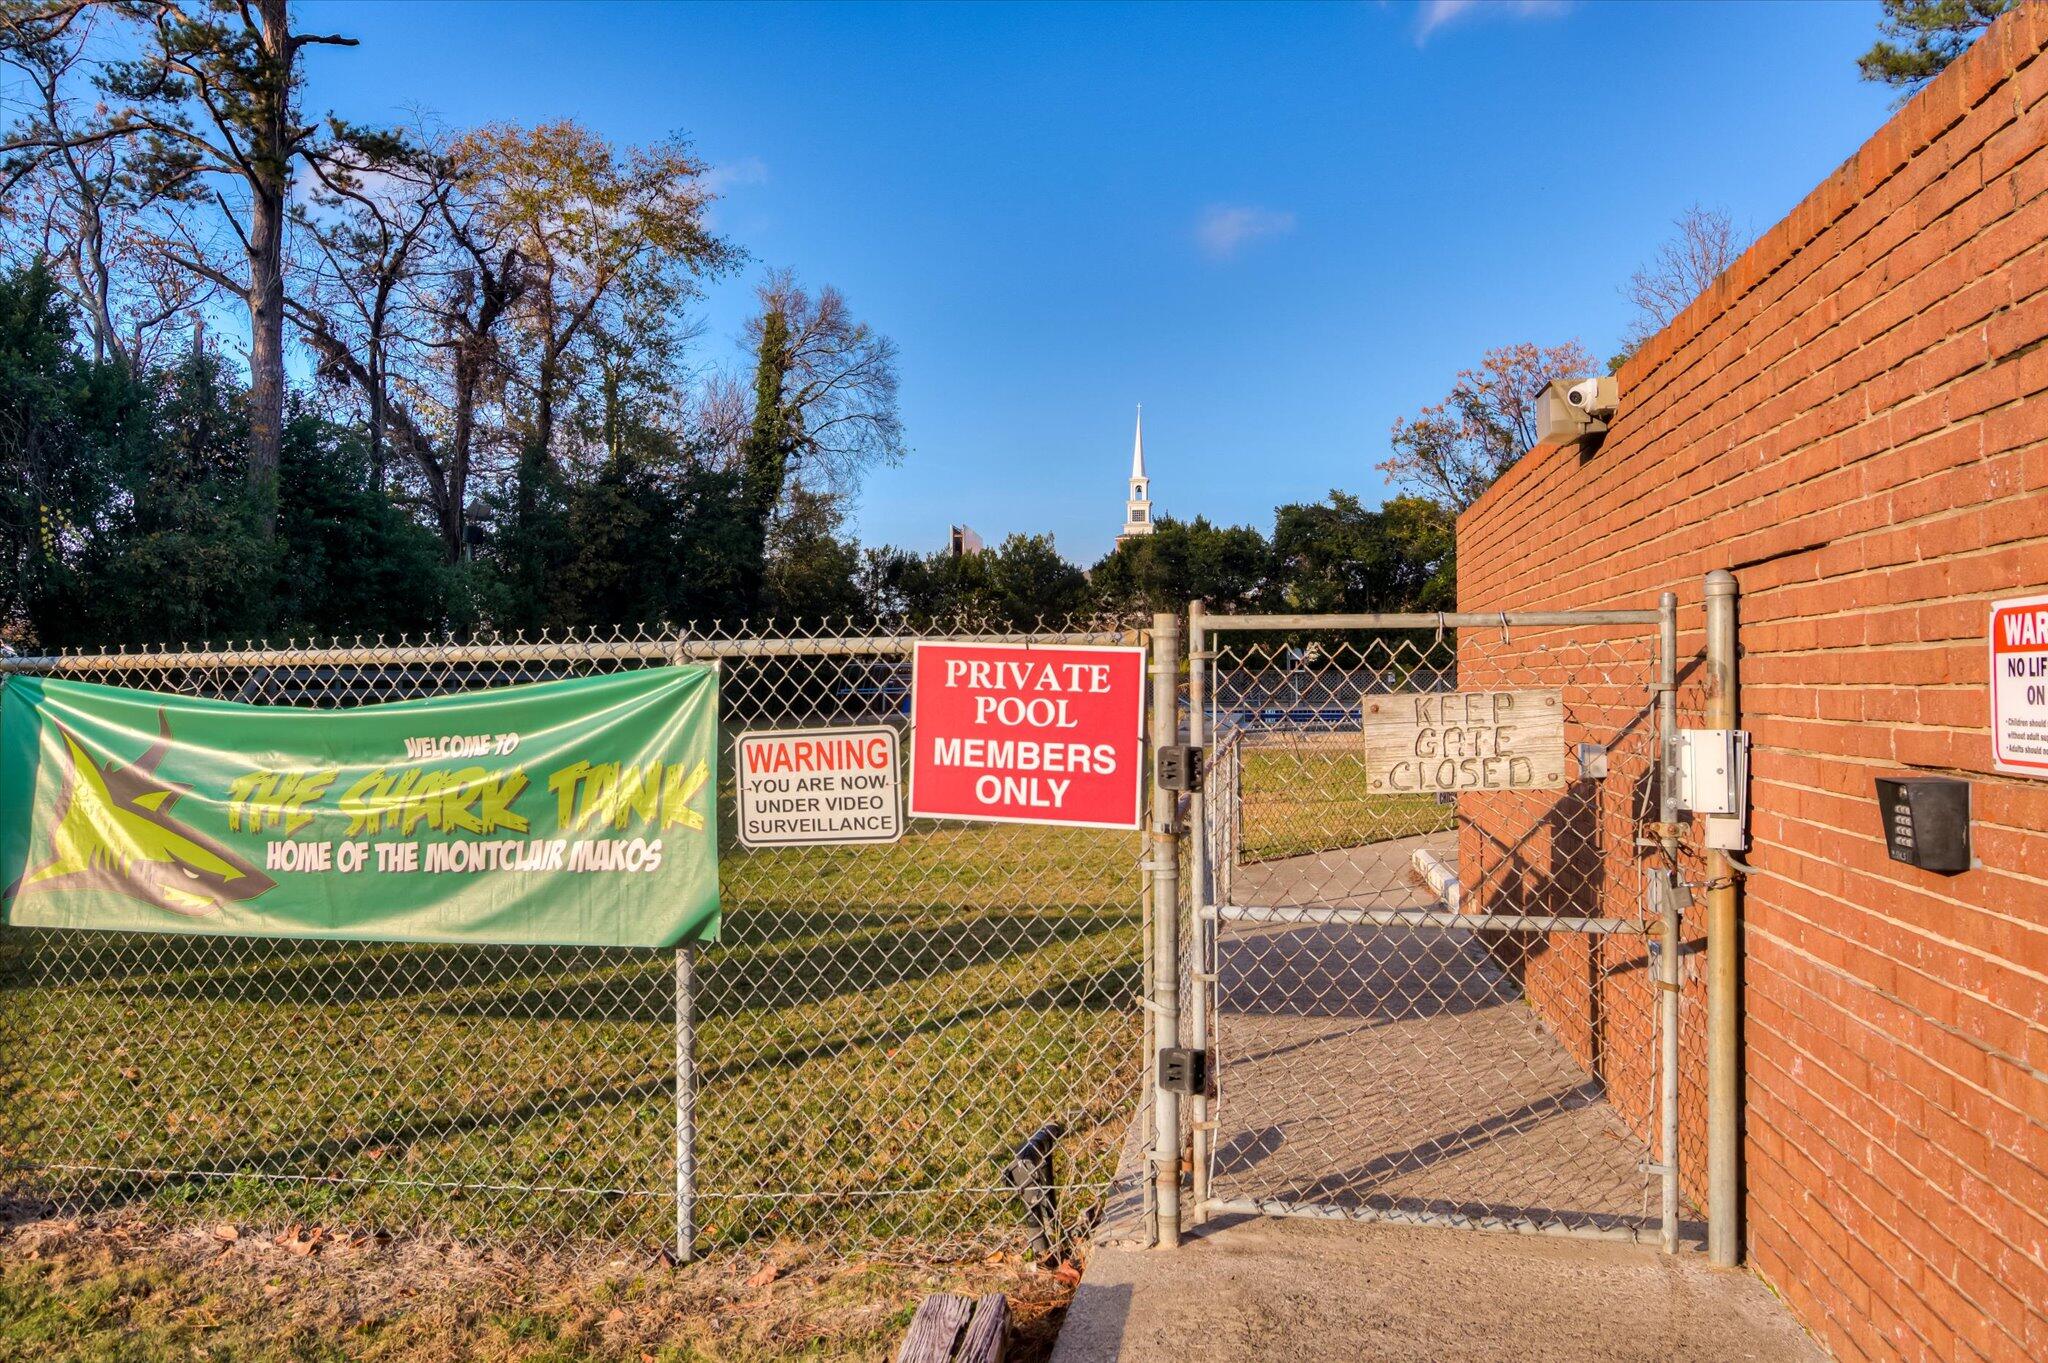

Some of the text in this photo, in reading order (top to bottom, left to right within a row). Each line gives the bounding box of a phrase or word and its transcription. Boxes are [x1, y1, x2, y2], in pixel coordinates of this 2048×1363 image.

[945, 659, 1111, 693] PRIVATE
[2008, 657, 2025, 677] NO
[1415, 693, 1514, 727] KEEP
[2027, 685, 2045, 705] ON
[974, 696, 1078, 728] POOL
[404, 732, 519, 758] WELCOME TO
[746, 738, 888, 774] WARNING
[934, 737, 1117, 775] MEMBERS
[1415, 725, 1517, 758] GATE
[751, 775, 886, 793] YOU ARE NOW
[1389, 756, 1535, 791] CLOSED
[228, 757, 711, 837] THE SHARK TANK
[756, 795, 884, 813] UNDER VIDEO
[975, 774, 1071, 808] ONLY
[748, 816, 893, 834] SURVEILLANCE
[266, 837, 663, 873] HOME OF THE MONTCLAIR MAKOS
